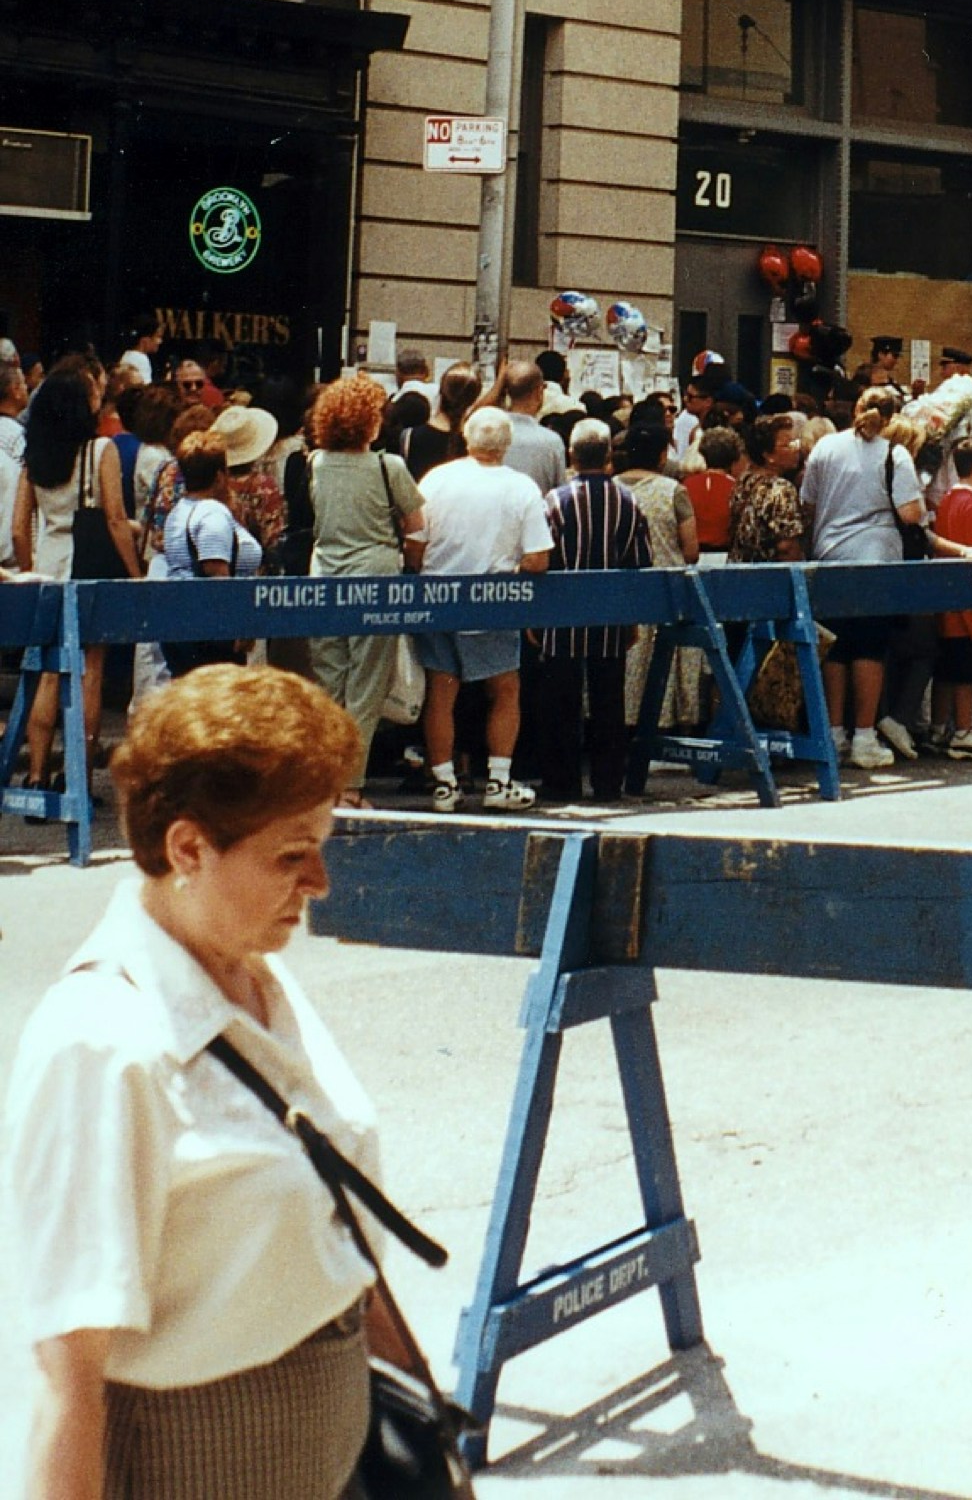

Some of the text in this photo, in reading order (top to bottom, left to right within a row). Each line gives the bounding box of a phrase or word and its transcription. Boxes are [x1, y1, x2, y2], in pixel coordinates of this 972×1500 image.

[428, 121, 450, 141] NO
[695, 170, 731, 208] 20
[155, 307, 291, 350] WALKER'S
[255, 581, 534, 607] POLICE LINE DO NOT CROSS
[363, 612, 400, 625] POLICE
[552, 1253, 649, 1323] POLICE DEPT.
